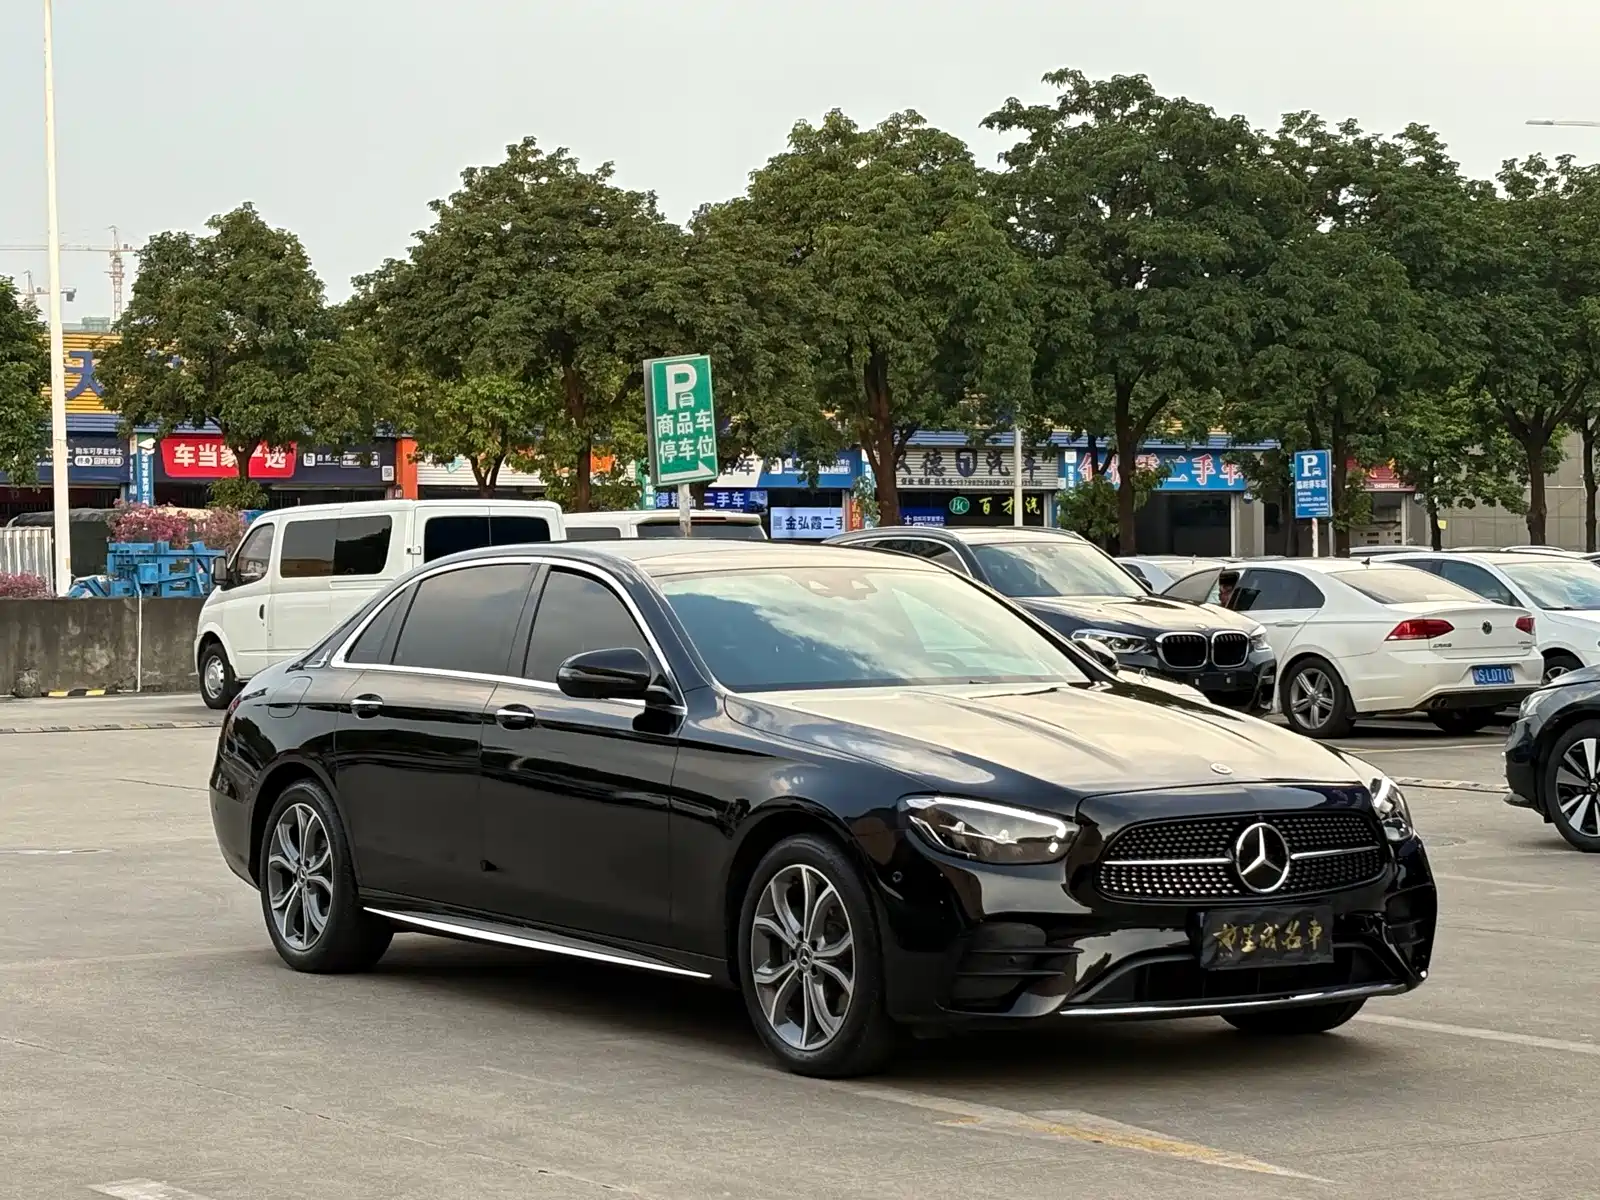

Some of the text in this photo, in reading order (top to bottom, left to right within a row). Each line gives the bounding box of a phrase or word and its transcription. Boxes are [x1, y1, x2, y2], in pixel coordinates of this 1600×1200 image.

[666, 363, 697, 411] P
[656, 409, 712, 438] 商品车
[174, 443, 286, 468] 车当家选
[659, 435, 714, 464] 停车位
[1301, 455, 1318, 477] P
